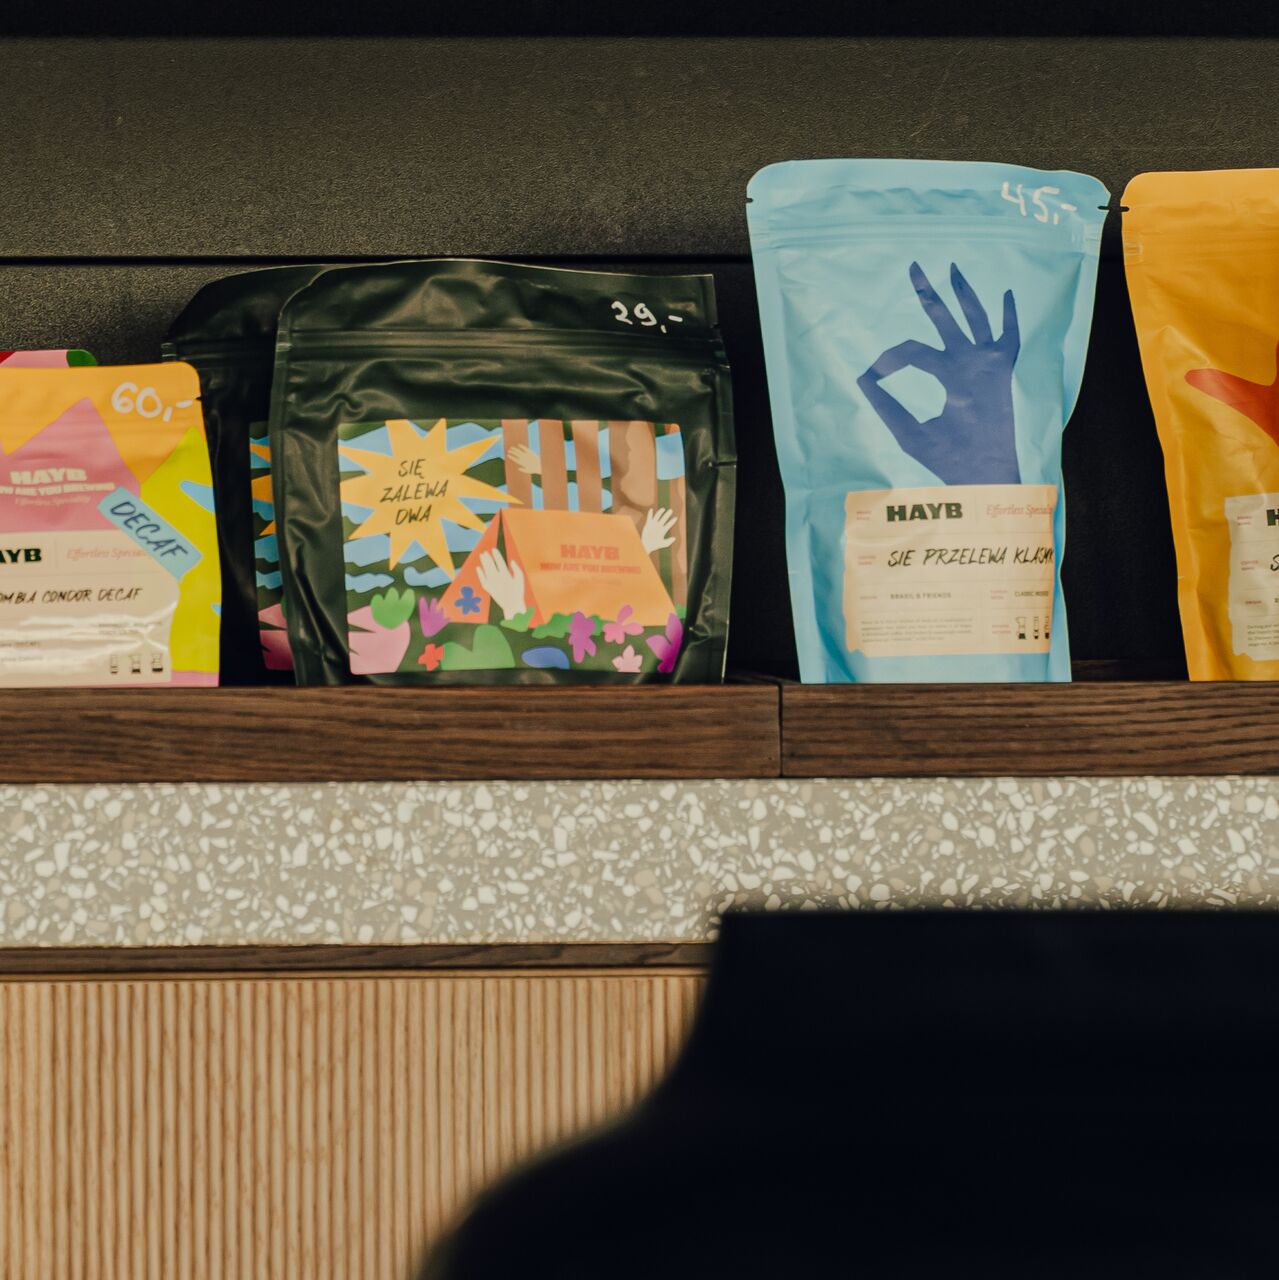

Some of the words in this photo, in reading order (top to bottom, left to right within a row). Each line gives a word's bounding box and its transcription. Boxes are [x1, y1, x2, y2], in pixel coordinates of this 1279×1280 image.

[10, 467, 88, 485] HAYB
[397, 458, 427, 480] SIĘ
[379, 478, 450, 504] ZALEWA
[394, 504, 433, 526] DWA
[885, 502, 964, 523] HAYB
[109, 500, 189, 557] DECAF
[559, 544, 621, 561] HAYB
[922, 546, 1008, 566] PRZELEWA
[96, 587, 144, 603] DECAF
